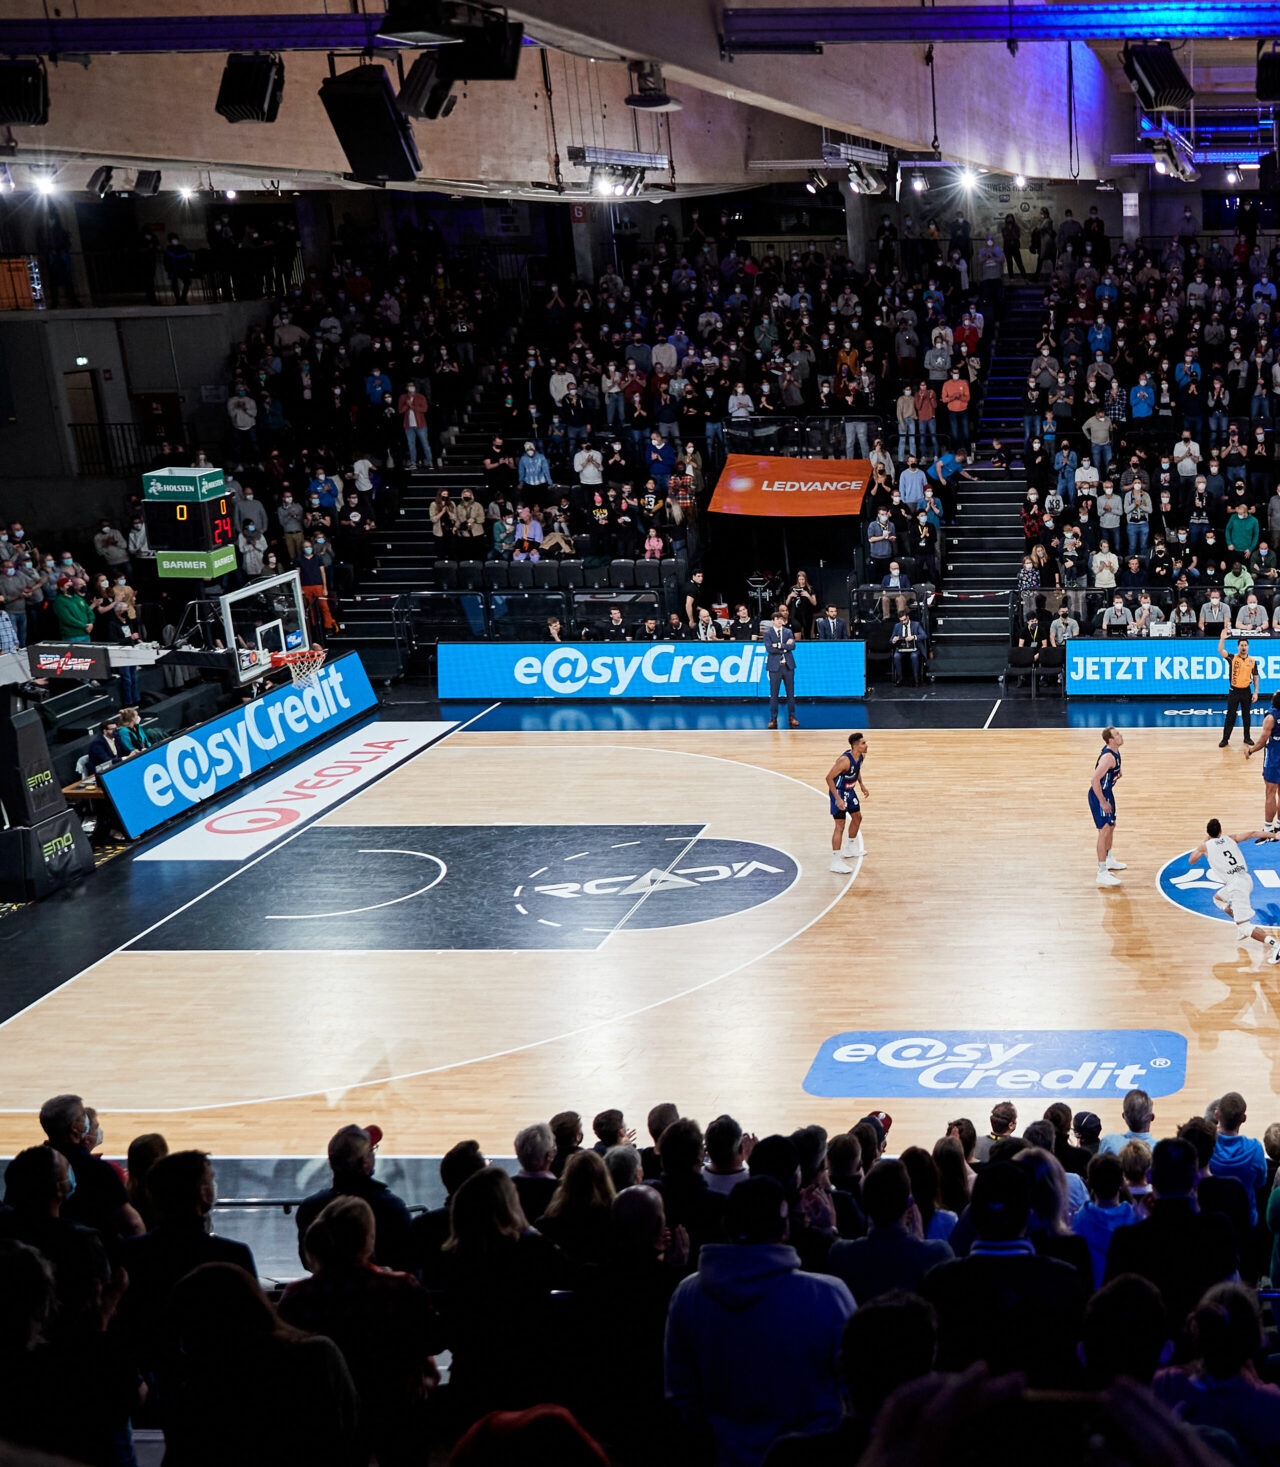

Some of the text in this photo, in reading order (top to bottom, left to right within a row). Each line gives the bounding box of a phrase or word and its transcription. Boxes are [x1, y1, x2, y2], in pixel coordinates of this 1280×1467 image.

[574, 206, 583, 218] G
[163, 484, 194, 493] HOLSTEN
[761, 480, 863, 492] LEDVANCE
[177, 504, 187, 520] 0
[220, 499, 227, 515] 0
[214, 517, 232, 544] 24
[162, 560, 207, 569] BARMER
[214, 554, 234, 569] BARMER
[1070, 656, 1147, 680] JETZT
[27, 769, 53, 788] EMO
[265, 738, 410, 803] VEOLIA
[43, 832, 73, 856] EMO
[1223, 850, 1237, 866] 3
